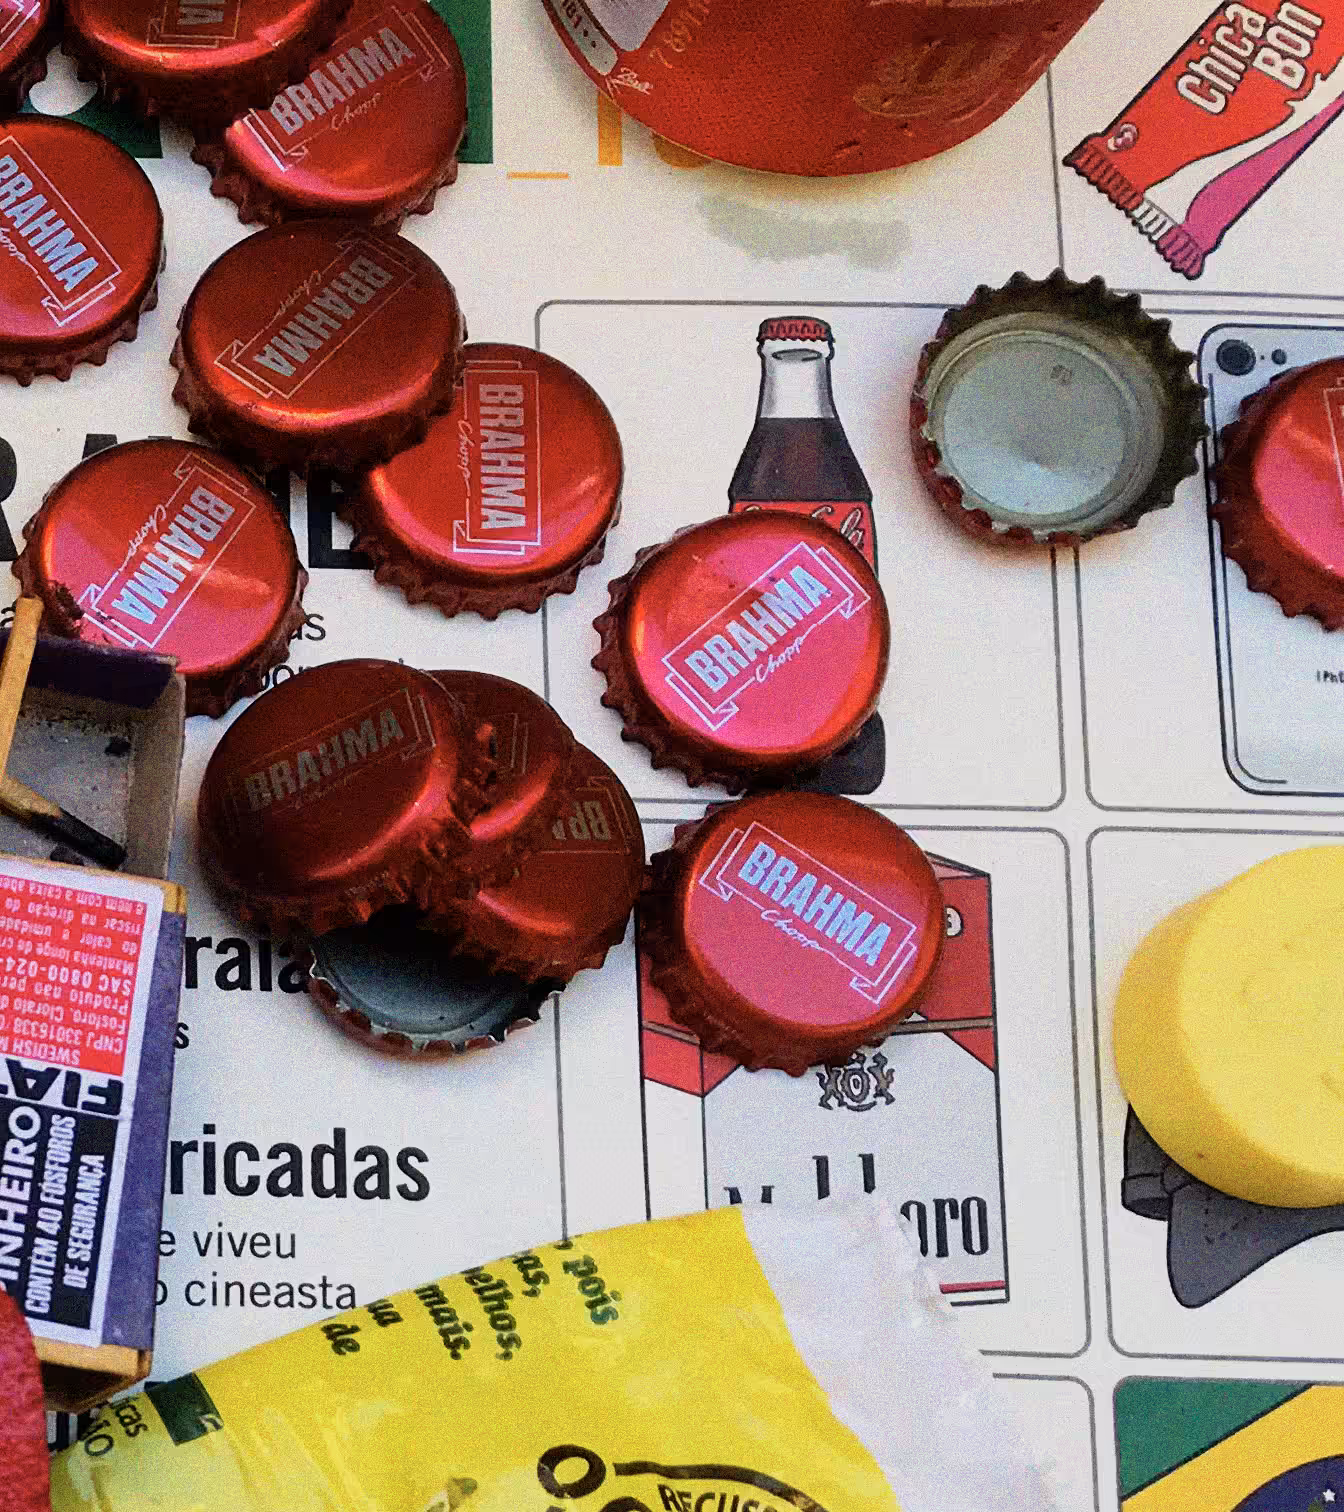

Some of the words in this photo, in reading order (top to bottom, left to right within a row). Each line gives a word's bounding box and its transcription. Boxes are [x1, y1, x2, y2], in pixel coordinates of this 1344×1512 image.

[271, 27, 415, 137] BRAHMA
[252, 255, 392, 377] BRAHMA
[479, 383, 525, 530] BRAHMA
[110, 485, 235, 625] BRAHMA
[684, 564, 833, 696] BRAHMA
[244, 707, 406, 814] BRAHMA
[738, 840, 894, 970] BRAHMA
[97, 974, 132, 996] SAC
[66, 1152, 108, 1262] SEGURANÇA
[193, 1221, 297, 1259] viveu
[62, 1263, 90, 1289] DE
[185, 1271, 357, 1310] cineasta
[564, 1254, 621, 1326] pois
[537, 1444, 606, 1499] O
